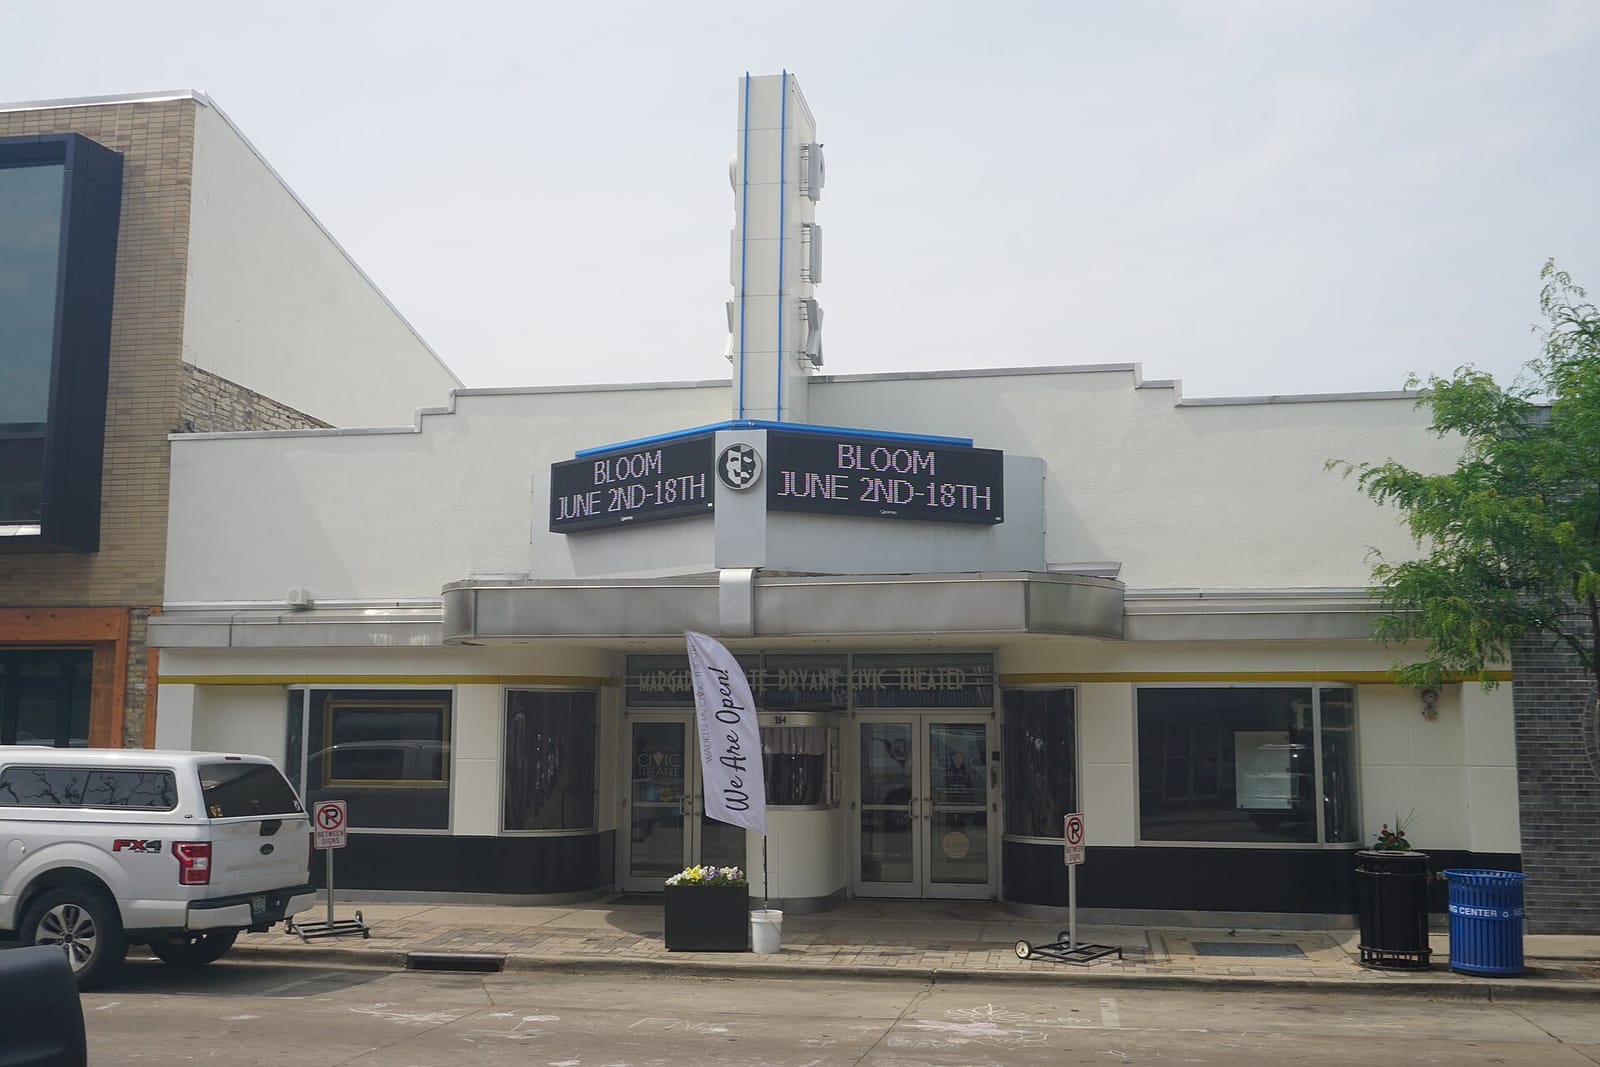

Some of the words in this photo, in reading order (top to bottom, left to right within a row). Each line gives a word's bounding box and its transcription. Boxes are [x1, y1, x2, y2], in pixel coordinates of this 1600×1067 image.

[593, 450, 662, 485] BLOOM
[838, 443, 935, 476] BLOOM
[556, 490, 602, 520] JUNE
[607, 473, 705, 512] 2ND-18TH
[777, 470, 849, 500] JUNE
[859, 477, 991, 511] 2ND-18TH
[708, 666, 745, 725] Open!
[850, 668, 887, 691] CIVIC
[897, 668, 966, 691] THEATER
[719, 730, 747, 772] Are
[723, 775, 750, 812] We
[112, 839, 162, 852] FX4
[1458, 906, 1498, 918] CENTER
